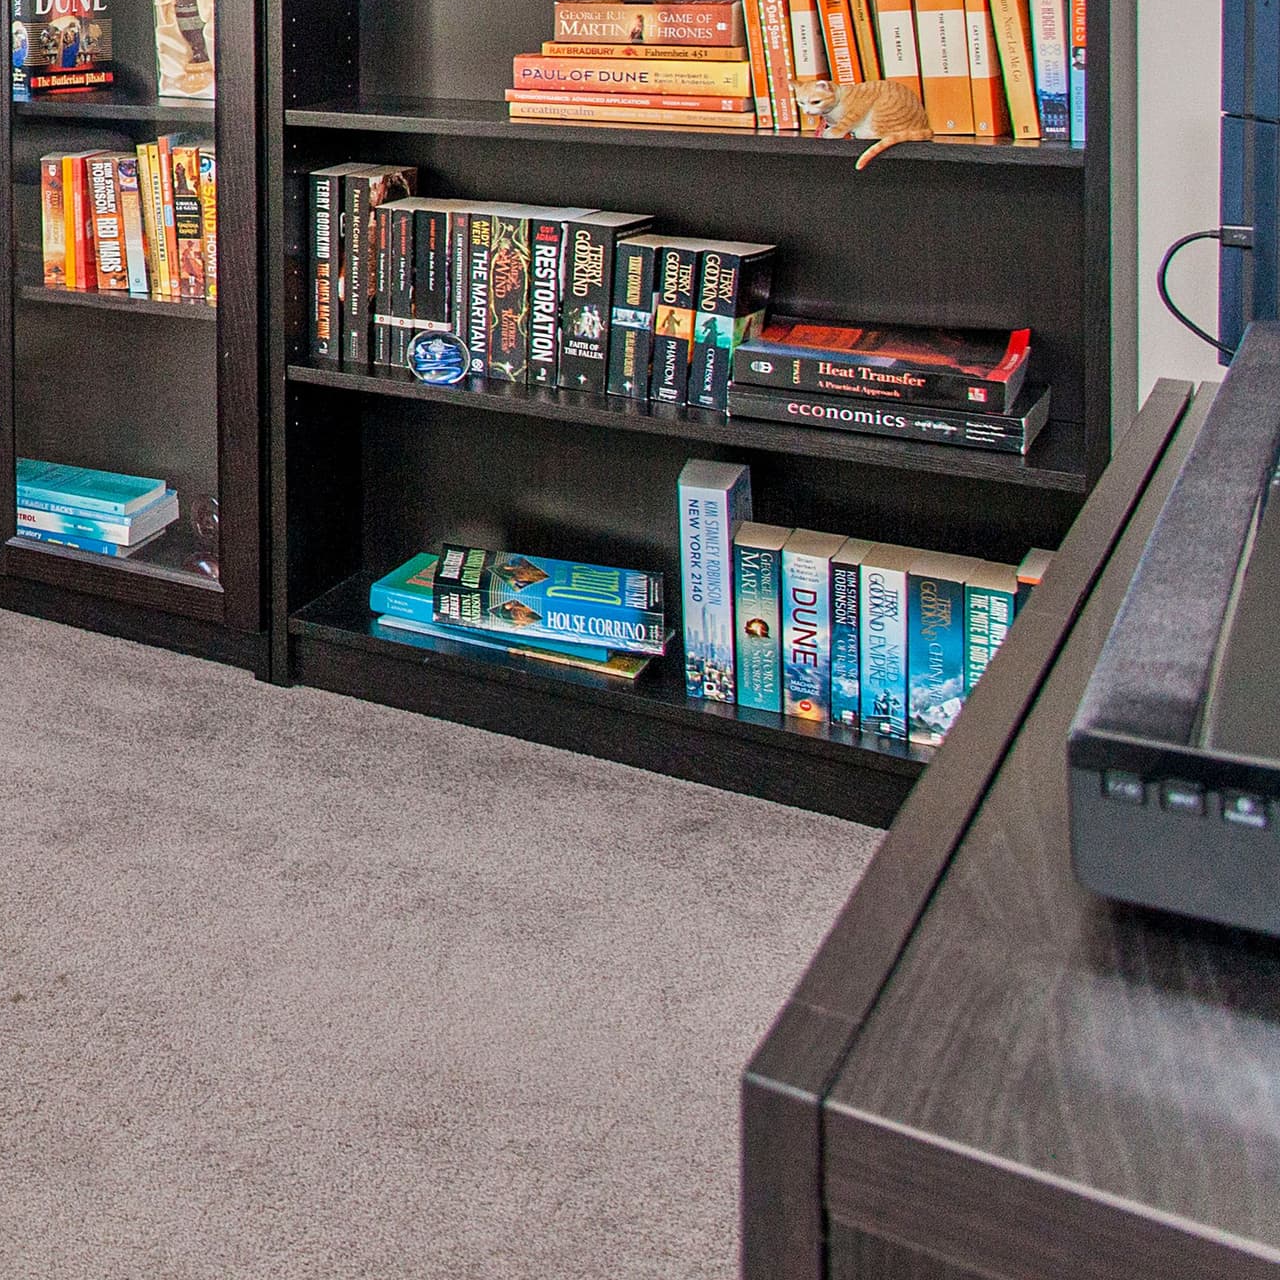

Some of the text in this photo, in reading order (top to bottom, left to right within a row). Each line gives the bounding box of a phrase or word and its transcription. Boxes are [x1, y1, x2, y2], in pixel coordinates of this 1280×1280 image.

[559, 21, 630, 36] MARTIN
[647, 24, 713, 39] THRONES
[657, 12, 713, 24] GAME OF
[644, 48, 689, 58] Fahrenheit
[941, 49, 949, 74] HISTORY
[37, 72, 106, 87] The Butlerian Jihad
[522, 69, 649, 83] PAUL OF DUNE
[92, 162, 107, 214] ROBINSON
[103, 162, 117, 214] KIM STANLEY
[202, 186, 216, 231] SAND
[96, 217, 122, 273] RED MARS
[472, 220, 481, 245] WEIR
[481, 220, 490, 248] ANDY
[316, 179, 330, 340] TERRY GOODKIND MACHINE
[573, 229, 590, 297] GOODKIND
[590, 244, 604, 287] TERRY
[663, 251, 680, 304] GOODKIND
[679, 264, 693, 297] TERRY
[471, 250, 488, 353] THE MARTIAN
[531, 244, 558, 363] RESTORATION
[701, 253, 720, 311] GOODKIND
[718, 268, 736, 304] TERRY
[664, 340, 677, 386] PHANTOM
[818, 362, 855, 379] Heat
[857, 367, 927, 388] Transfer
[787, 401, 907, 429] economics
[688, 498, 703, 603] NEW YORK 2140
[704, 518, 722, 606] STANLEY ROBINSON
[835, 569, 847, 625] ROBINSON
[868, 573, 885, 632] GOODKIND
[970, 593, 988, 611] THE
[547, 611, 645, 642] HOUSE CORRINO
[791, 587, 818, 668] DUNE
